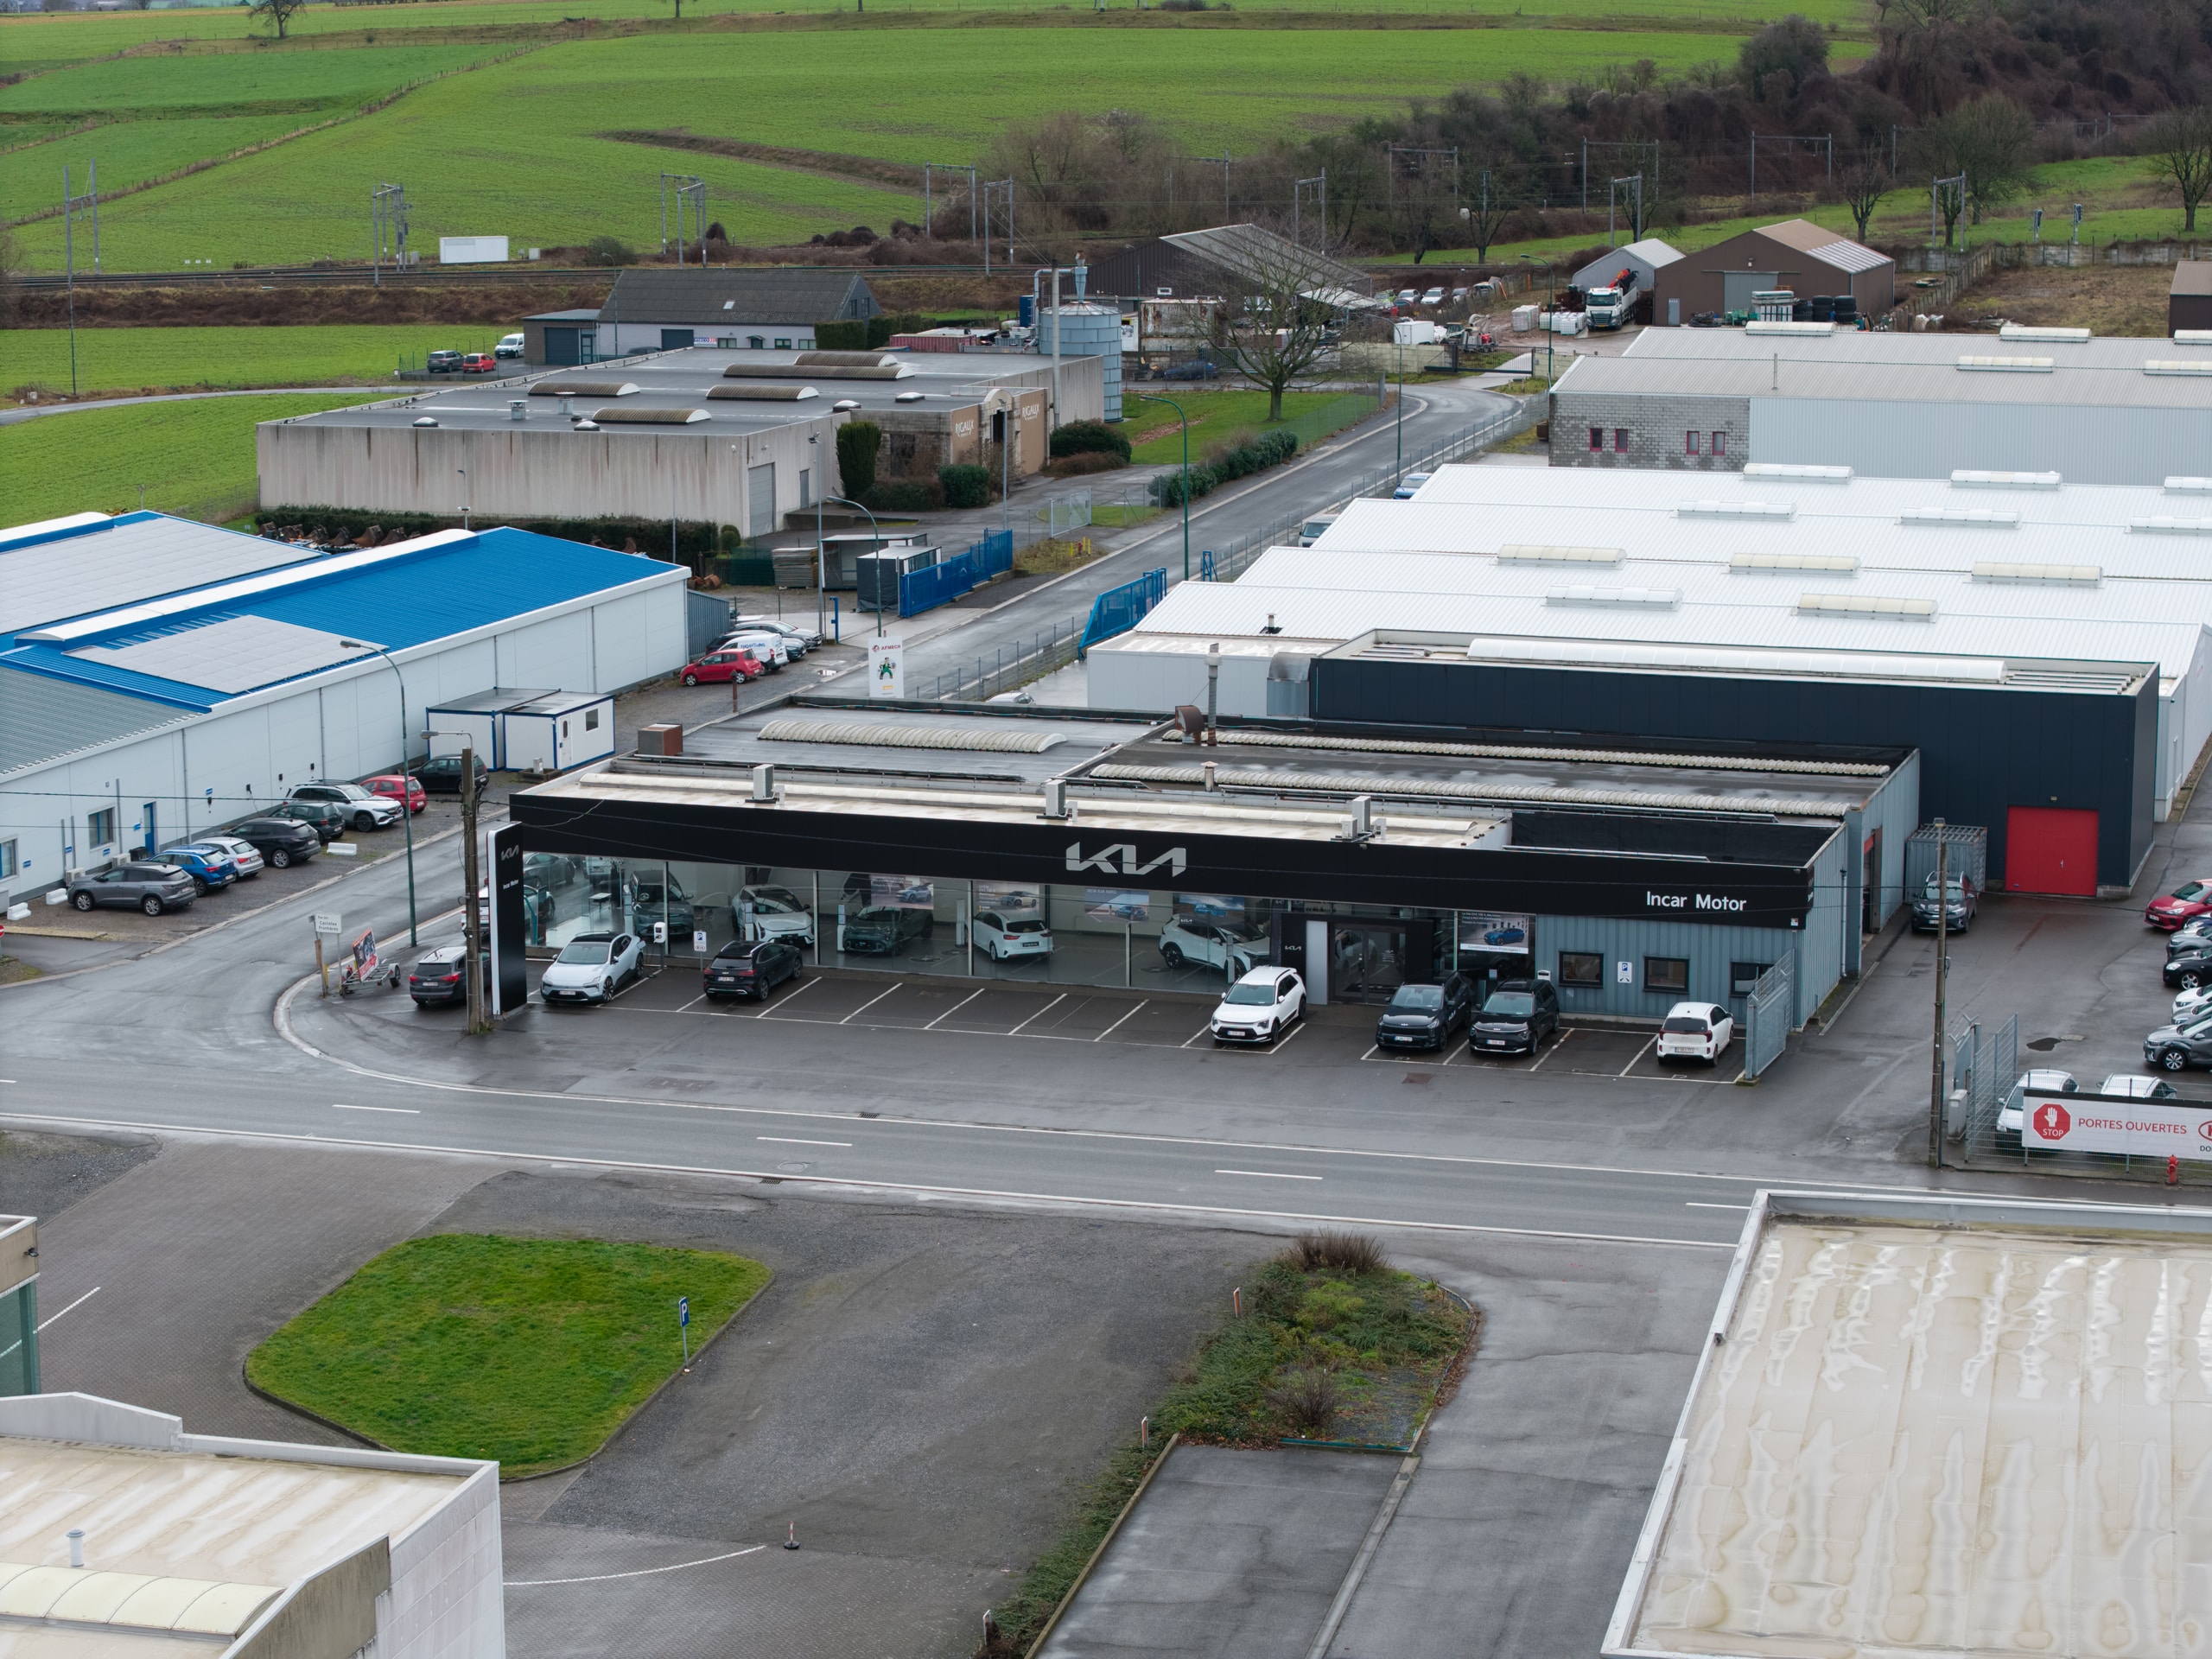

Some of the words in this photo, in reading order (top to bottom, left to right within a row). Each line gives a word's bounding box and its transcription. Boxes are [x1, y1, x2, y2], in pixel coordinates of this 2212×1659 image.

[1022, 404, 1039, 421] RIGAUX
[955, 420, 974, 436] RIGAUX
[501, 845, 519, 861] KIA
[1065, 842, 1186, 878] KIA
[1646, 891, 1688, 908] Incar
[1695, 893, 1747, 912] Motor
[2043, 1128, 2063, 1137] STOP
[2078, 1117, 2123, 1129] PORTES
[2125, 1121, 2187, 1134] OUVERTES
